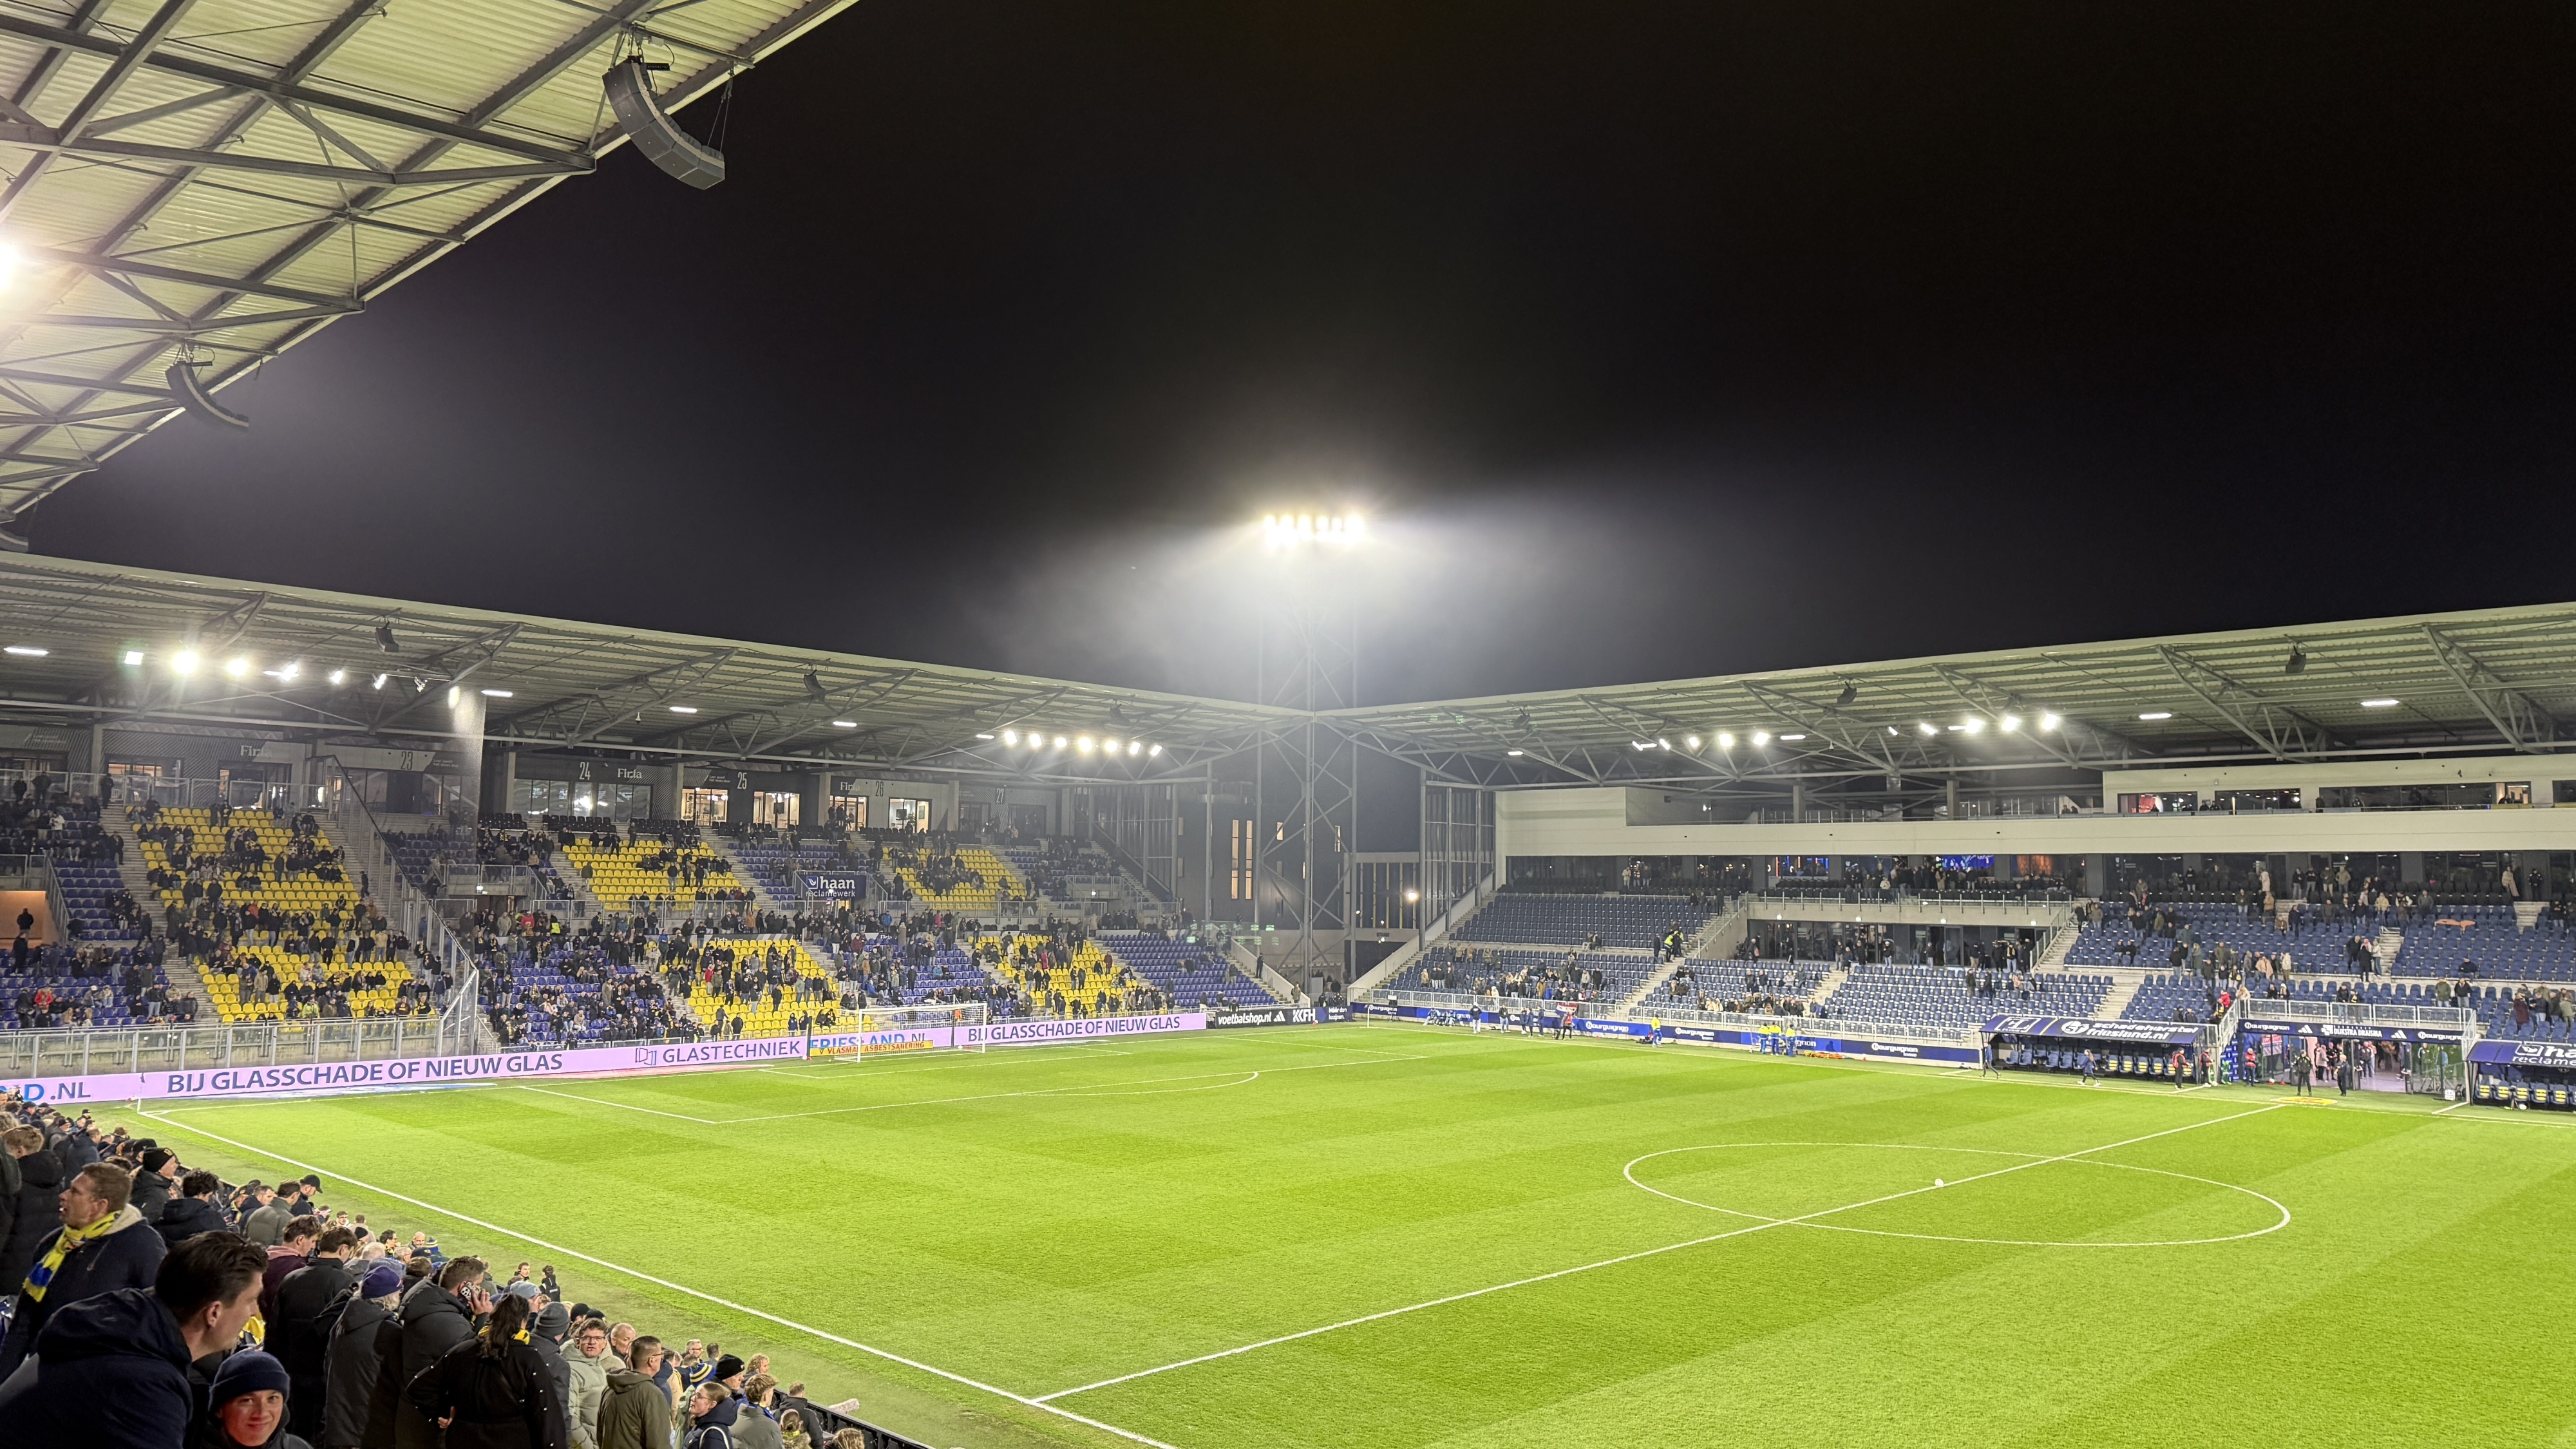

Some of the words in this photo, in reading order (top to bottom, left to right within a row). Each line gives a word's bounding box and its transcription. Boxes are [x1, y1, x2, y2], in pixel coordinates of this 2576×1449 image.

[401, 751, 413, 770] 23
[580, 761, 591, 781] 24
[737, 772, 747, 790] 25
[875, 781, 884, 797] 26
[996, 788, 1004, 803] 27
[820, 876, 855, 889] haan
[1218, 1011, 1272, 1025] voetbalshop.nl
[968, 1027, 988, 1041] BIJ
[991, 1022, 1083, 1040] GLASSCHADE
[1085, 1021, 1103, 1034] OF
[1105, 1018, 1148, 1034] NIEUW
[1150, 1016, 1180, 1030] GLAS
[663, 1041, 800, 1063] GLASTECHNIEK
[828, 1046, 858, 1054] VLASMA
[864, 1041, 925, 1052] ASBESTSANERING
[167, 1073, 205, 1093] BIJ
[211, 1064, 383, 1090] GLASSCHADE
[388, 1061, 420, 1080] OF
[425, 1057, 502, 1077] NIEUW
[507, 1054, 563, 1072] GLAS
